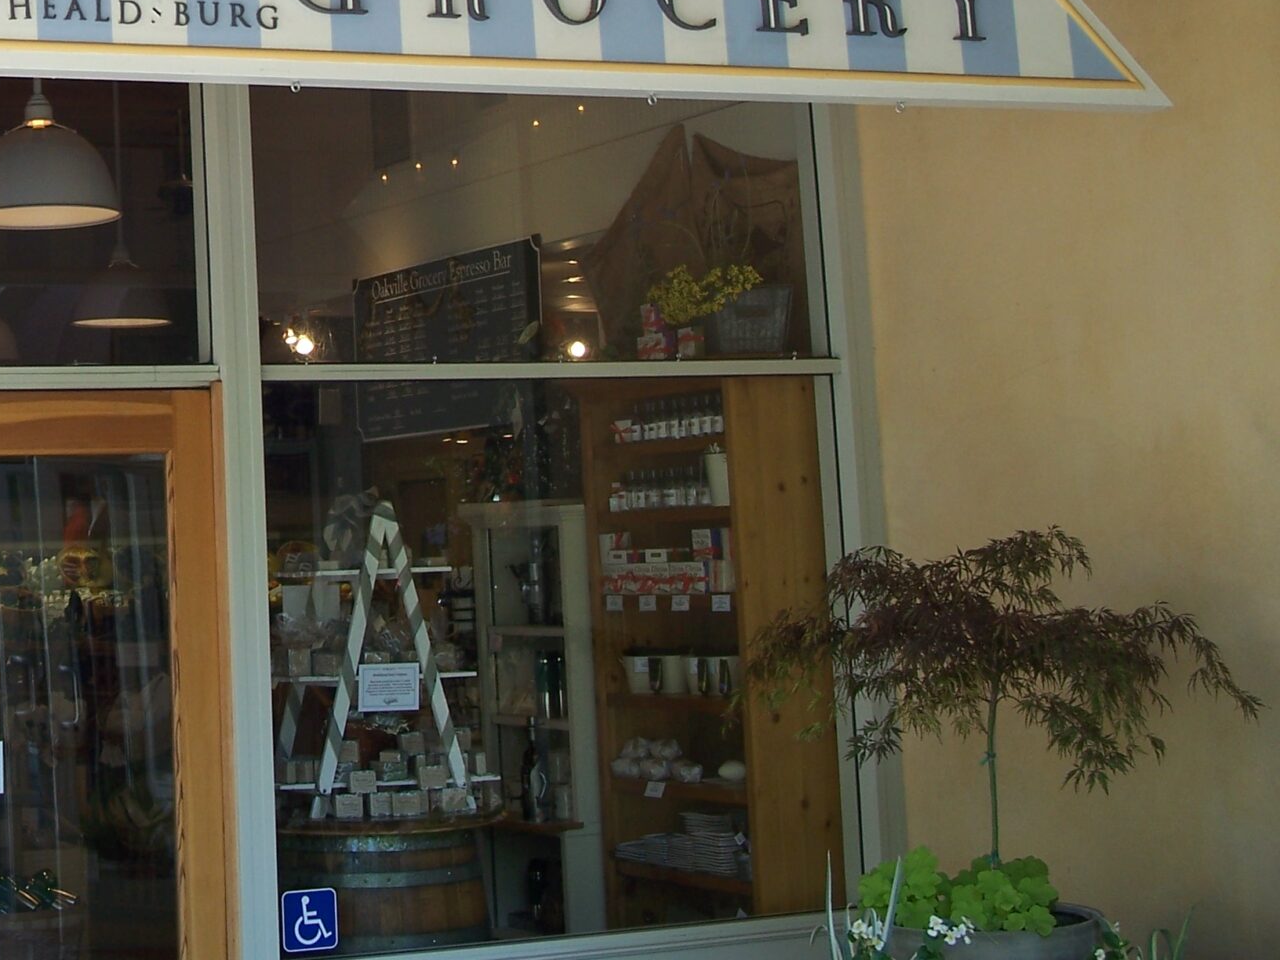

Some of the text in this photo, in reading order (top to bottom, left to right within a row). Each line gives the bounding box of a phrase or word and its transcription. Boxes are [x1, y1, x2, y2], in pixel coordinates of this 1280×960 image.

[371, 273, 408, 300] Oakville
[448, 258, 490, 283] Espresso
[493, 250, 512, 271] Bar
